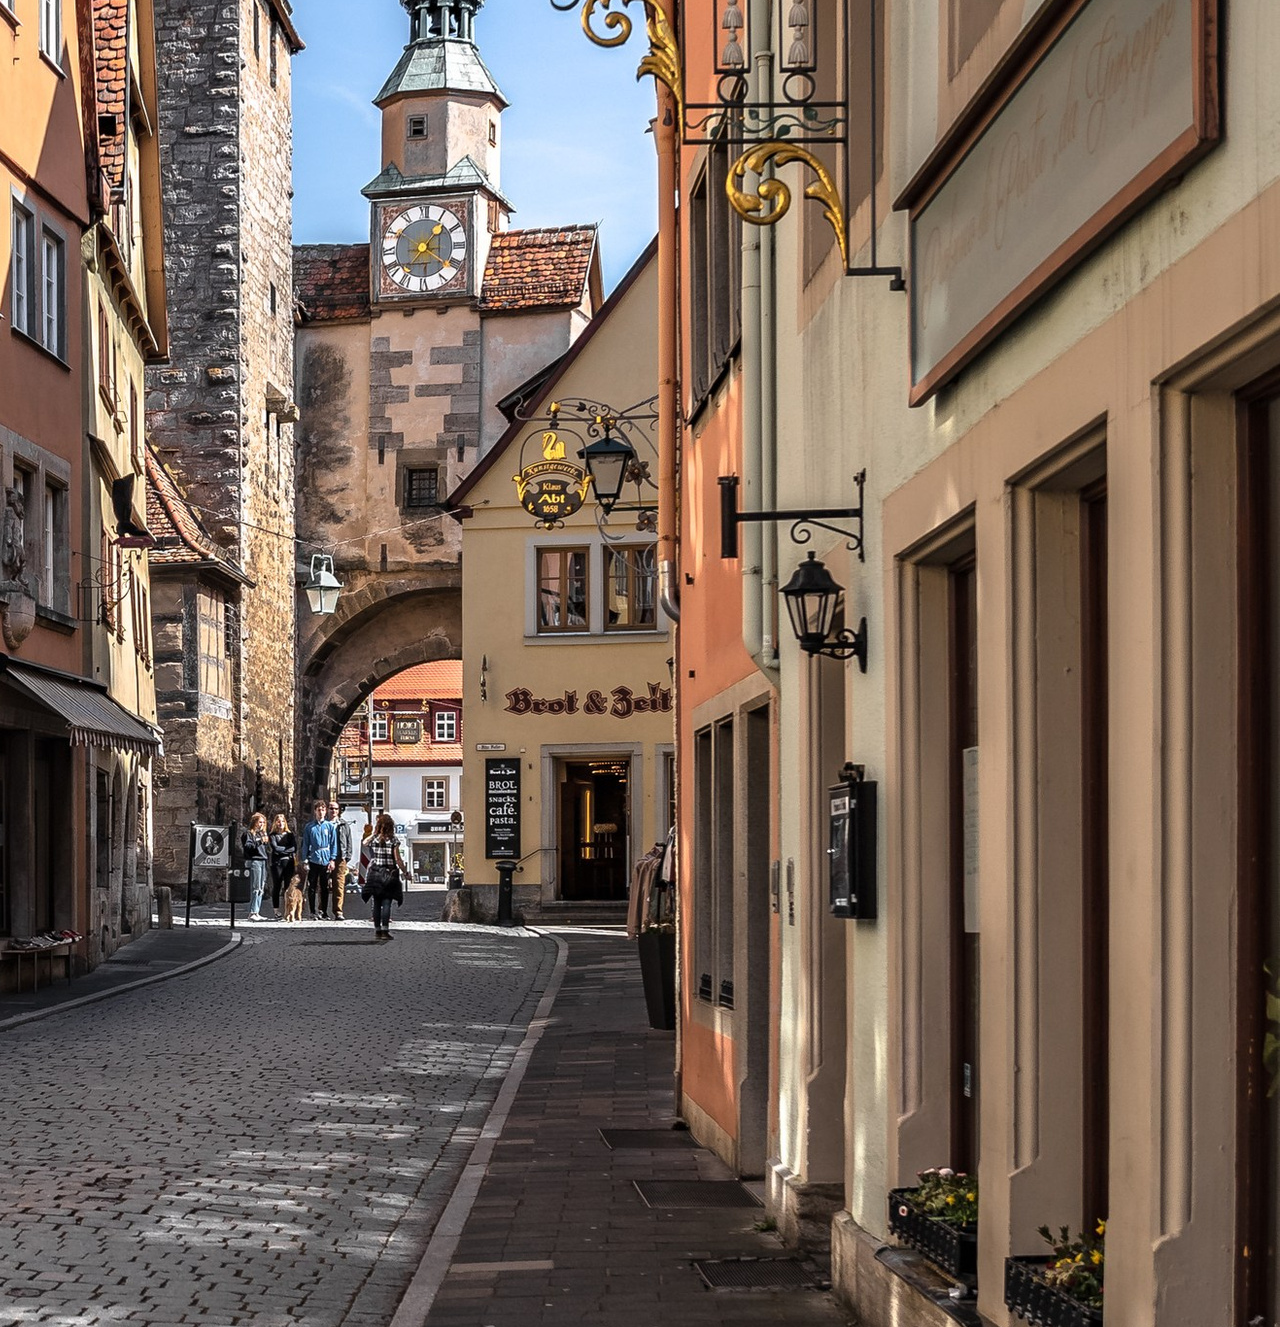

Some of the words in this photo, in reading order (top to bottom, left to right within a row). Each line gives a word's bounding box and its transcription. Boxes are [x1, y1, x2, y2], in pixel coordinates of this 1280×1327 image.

[542, 482, 562, 491] Klaus
[538, 493, 565, 504] Abt
[542, 505, 559, 513] 1658
[503, 687, 580, 715] Brot
[583, 690, 608, 715] &
[610, 681, 673, 719] Zeit
[489, 802, 517, 815] café.
[489, 817, 517, 826] pasta.
